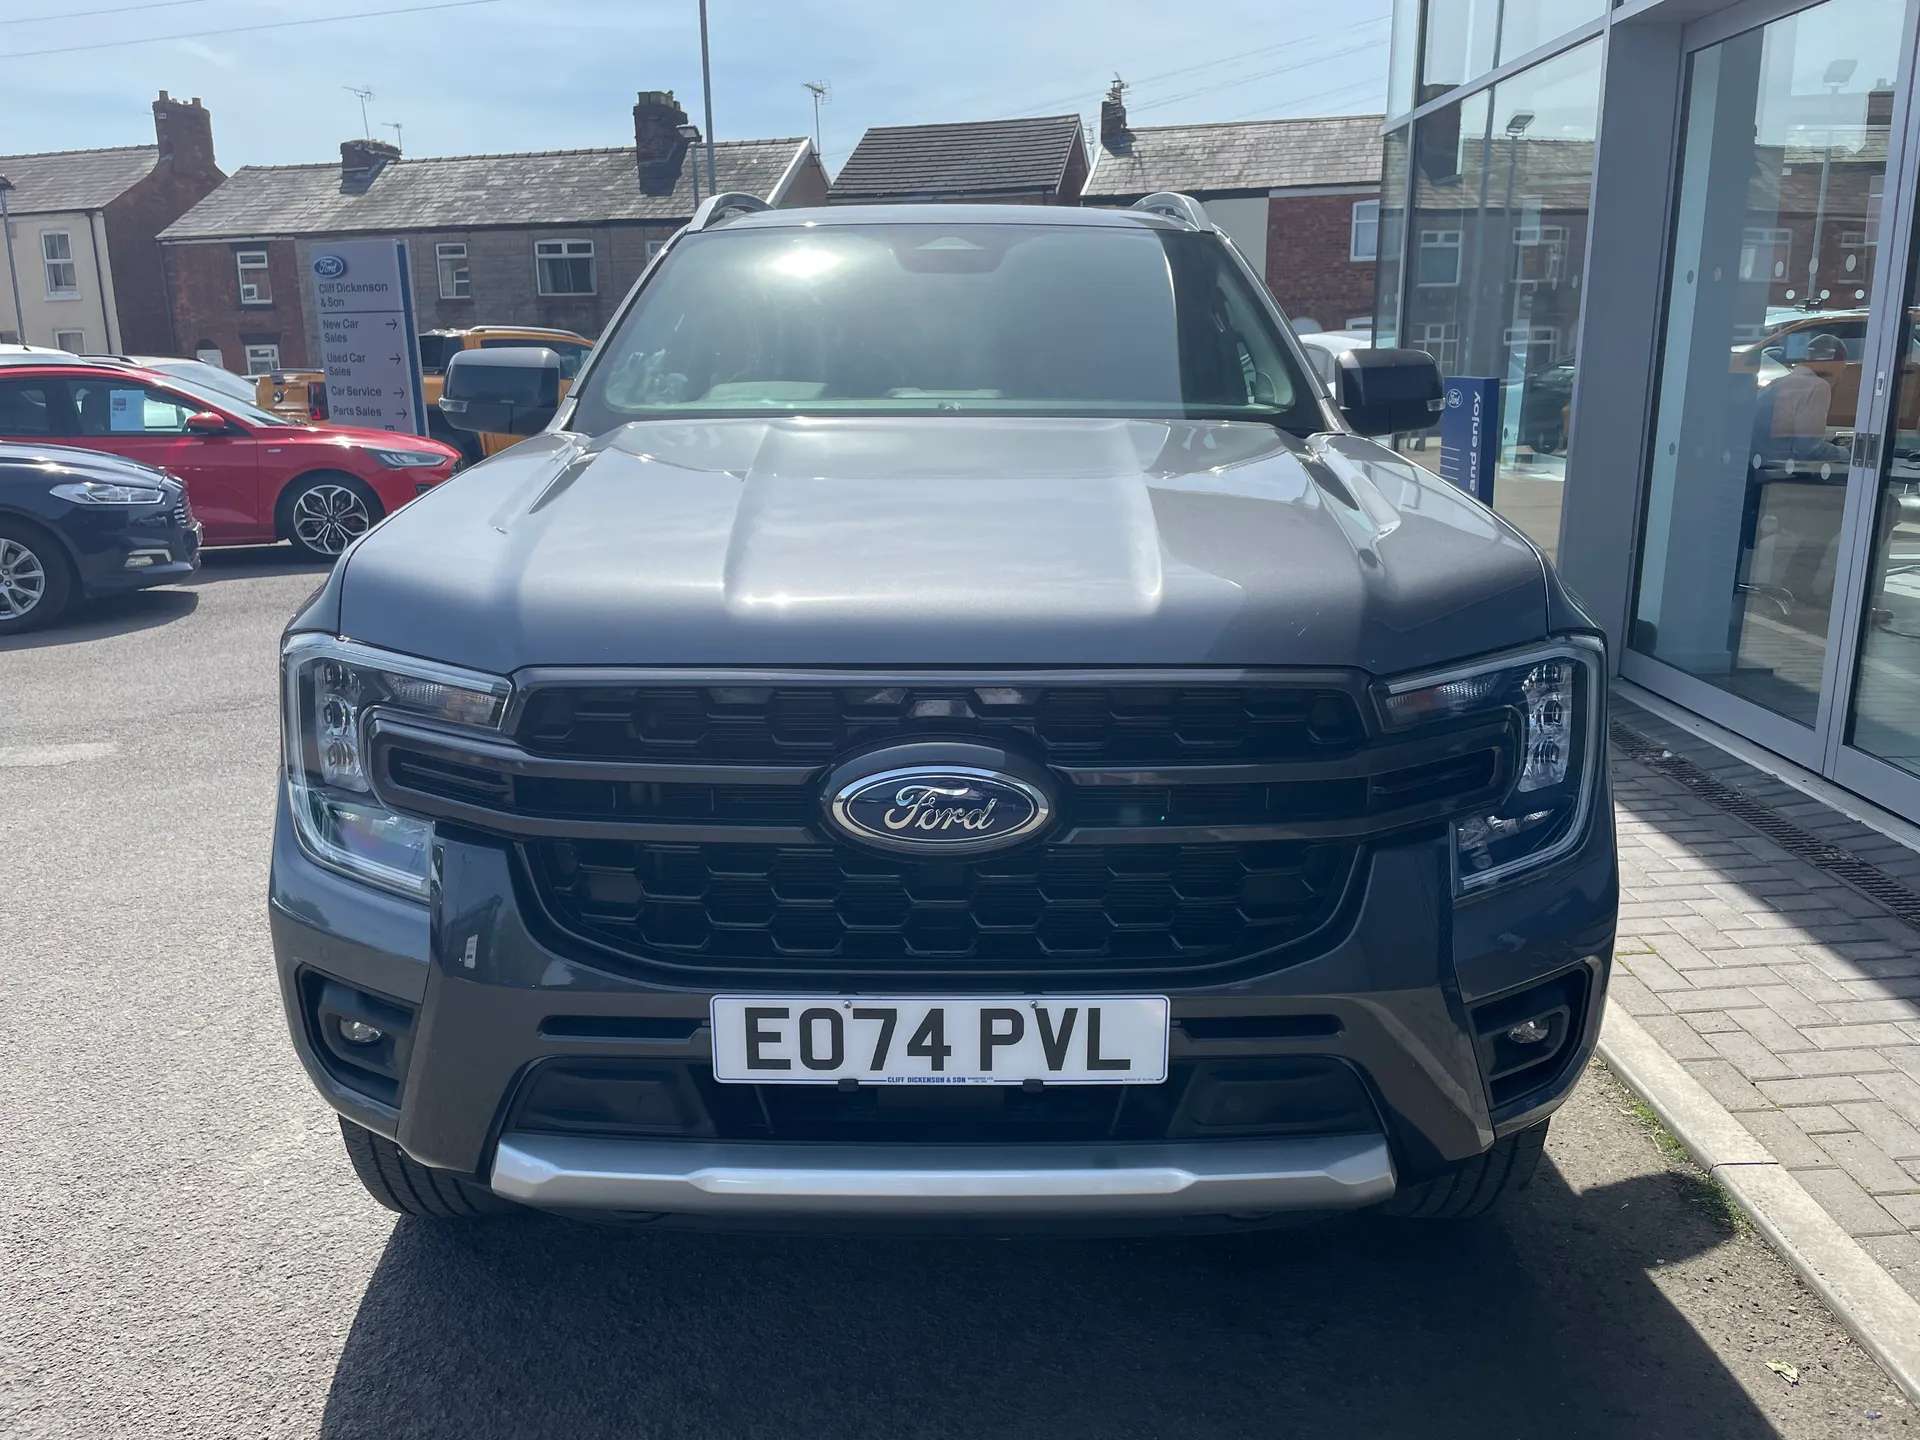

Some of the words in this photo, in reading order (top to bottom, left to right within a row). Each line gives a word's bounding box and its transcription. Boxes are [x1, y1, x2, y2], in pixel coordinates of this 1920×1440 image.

[319, 283, 336, 294] Cliff
[336, 282, 388, 294] Dickenson
[320, 298, 327, 308] &
[328, 297, 345, 308] Son
[323, 319, 341, 329] New
[343, 318, 359, 329] Car
[324, 333, 348, 343] Sales
[327, 353, 349, 363] Used
[350, 353, 366, 363] Car
[328, 367, 351, 377] Sales
[331, 386, 345, 396] Car
[346, 386, 382, 397] Service
[333, 405, 354, 416] Parts
[355, 406, 382, 417] Sales
[1471, 391, 1481, 448] enjoy
[1469, 451, 1477, 492] and
[884, 785, 998, 830] Ford
[744, 1006, 952, 1072] EO74
[979, 1006, 1132, 1072] PVL
